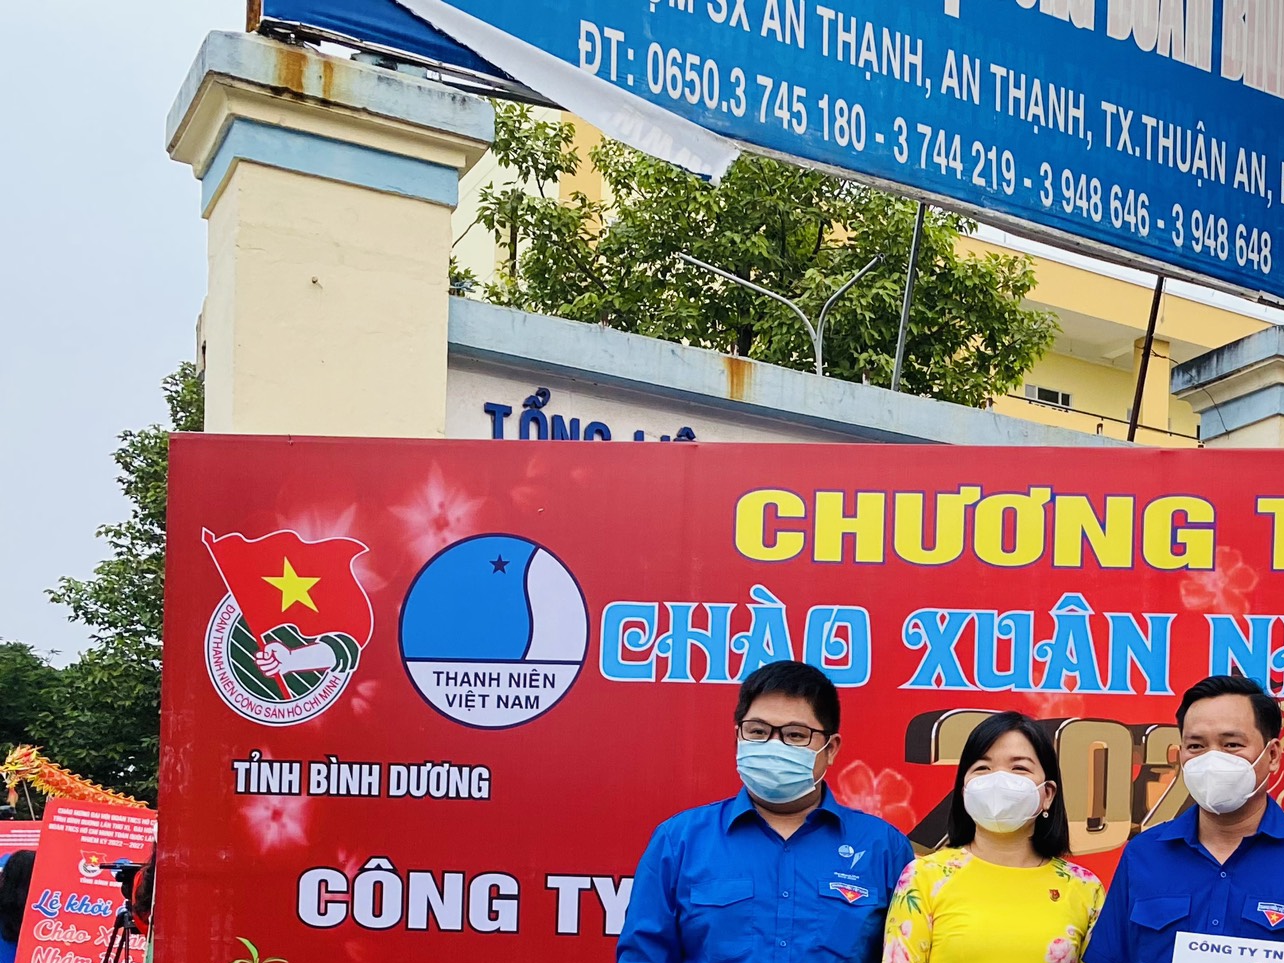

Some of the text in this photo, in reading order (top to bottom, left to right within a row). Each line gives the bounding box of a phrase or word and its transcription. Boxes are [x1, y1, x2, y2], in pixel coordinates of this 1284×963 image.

[760, 0, 805, 49] AN
[816, 4, 932, 99] THẠNH,
[940, 49, 981, 105] AN
[989, 63, 1093, 150] THẠNH,
[1233, 146, 1273, 208] AN,
[578, 19, 634, 86] ĐT:
[646, 42, 746, 118] 0650.3
[756, 73, 808, 135] 745
[818, 93, 867, 152] 180
[893, 116, 908, 164] 3
[916, 122, 963, 180] 744
[971, 140, 1016, 196] 219
[1039, 161, 1053, 207] 3
[1061, 168, 1102, 222] 948
[1109, 184, 1150, 237] 646
[1171, 203, 1184, 248] 3
[1191, 210, 1229, 261] 948
[1235, 223, 1272, 274] 648
[734, 484, 1216, 571] CHƯƠNG
[599, 583, 873, 688] CHÀO
[897, 592, 1179, 696] XUÂN
[212, 635, 224, 671] THANH
[219, 670, 238, 697] NIÊN
[304, 697, 321, 713] CHÍ
[319, 675, 342, 701] MINH
[432, 668, 556, 689] THANH NIÊN
[445, 690, 540, 711] VIỆT NAM
[232, 751, 492, 799] TỈNH BÌNH DƯƠNG
[31, 889, 62, 918] Lễ
[64, 893, 113, 916] khởi
[297, 856, 634, 936] CÔNG TY
[33, 918, 91, 944] Chào
[1188, 940, 1233, 955] CÔNG
[1238, 946, 1258, 957] TY
